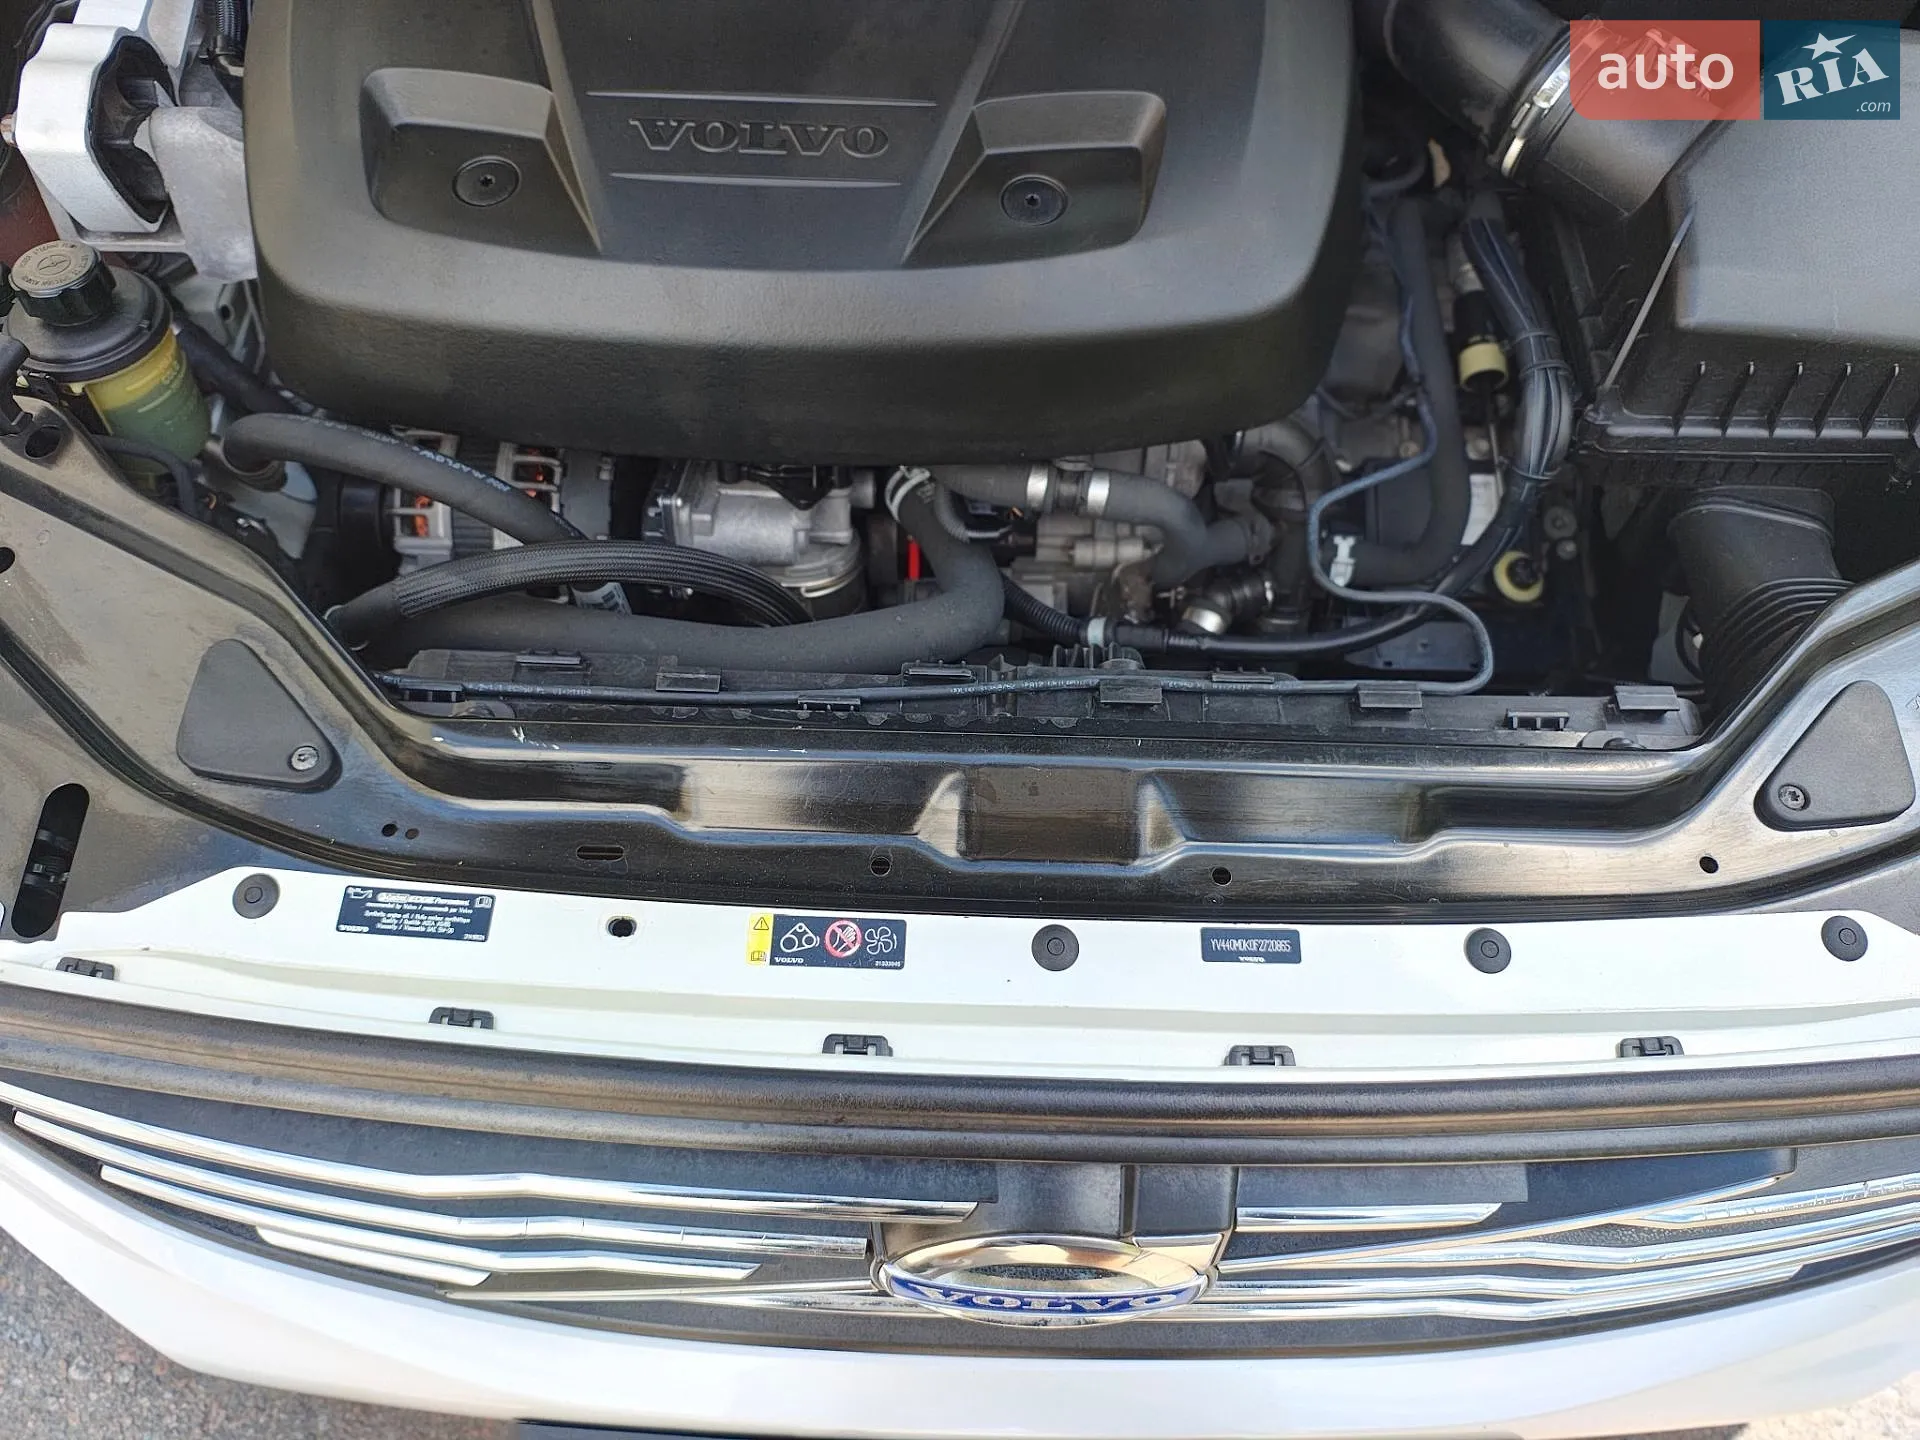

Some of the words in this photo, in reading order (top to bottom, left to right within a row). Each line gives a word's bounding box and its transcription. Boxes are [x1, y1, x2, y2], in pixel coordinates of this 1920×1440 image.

[628, 118, 889, 158] VOLVO
[774, 956, 804, 964] VOLVO
[908, 1278, 1177, 1311] VOLVO
